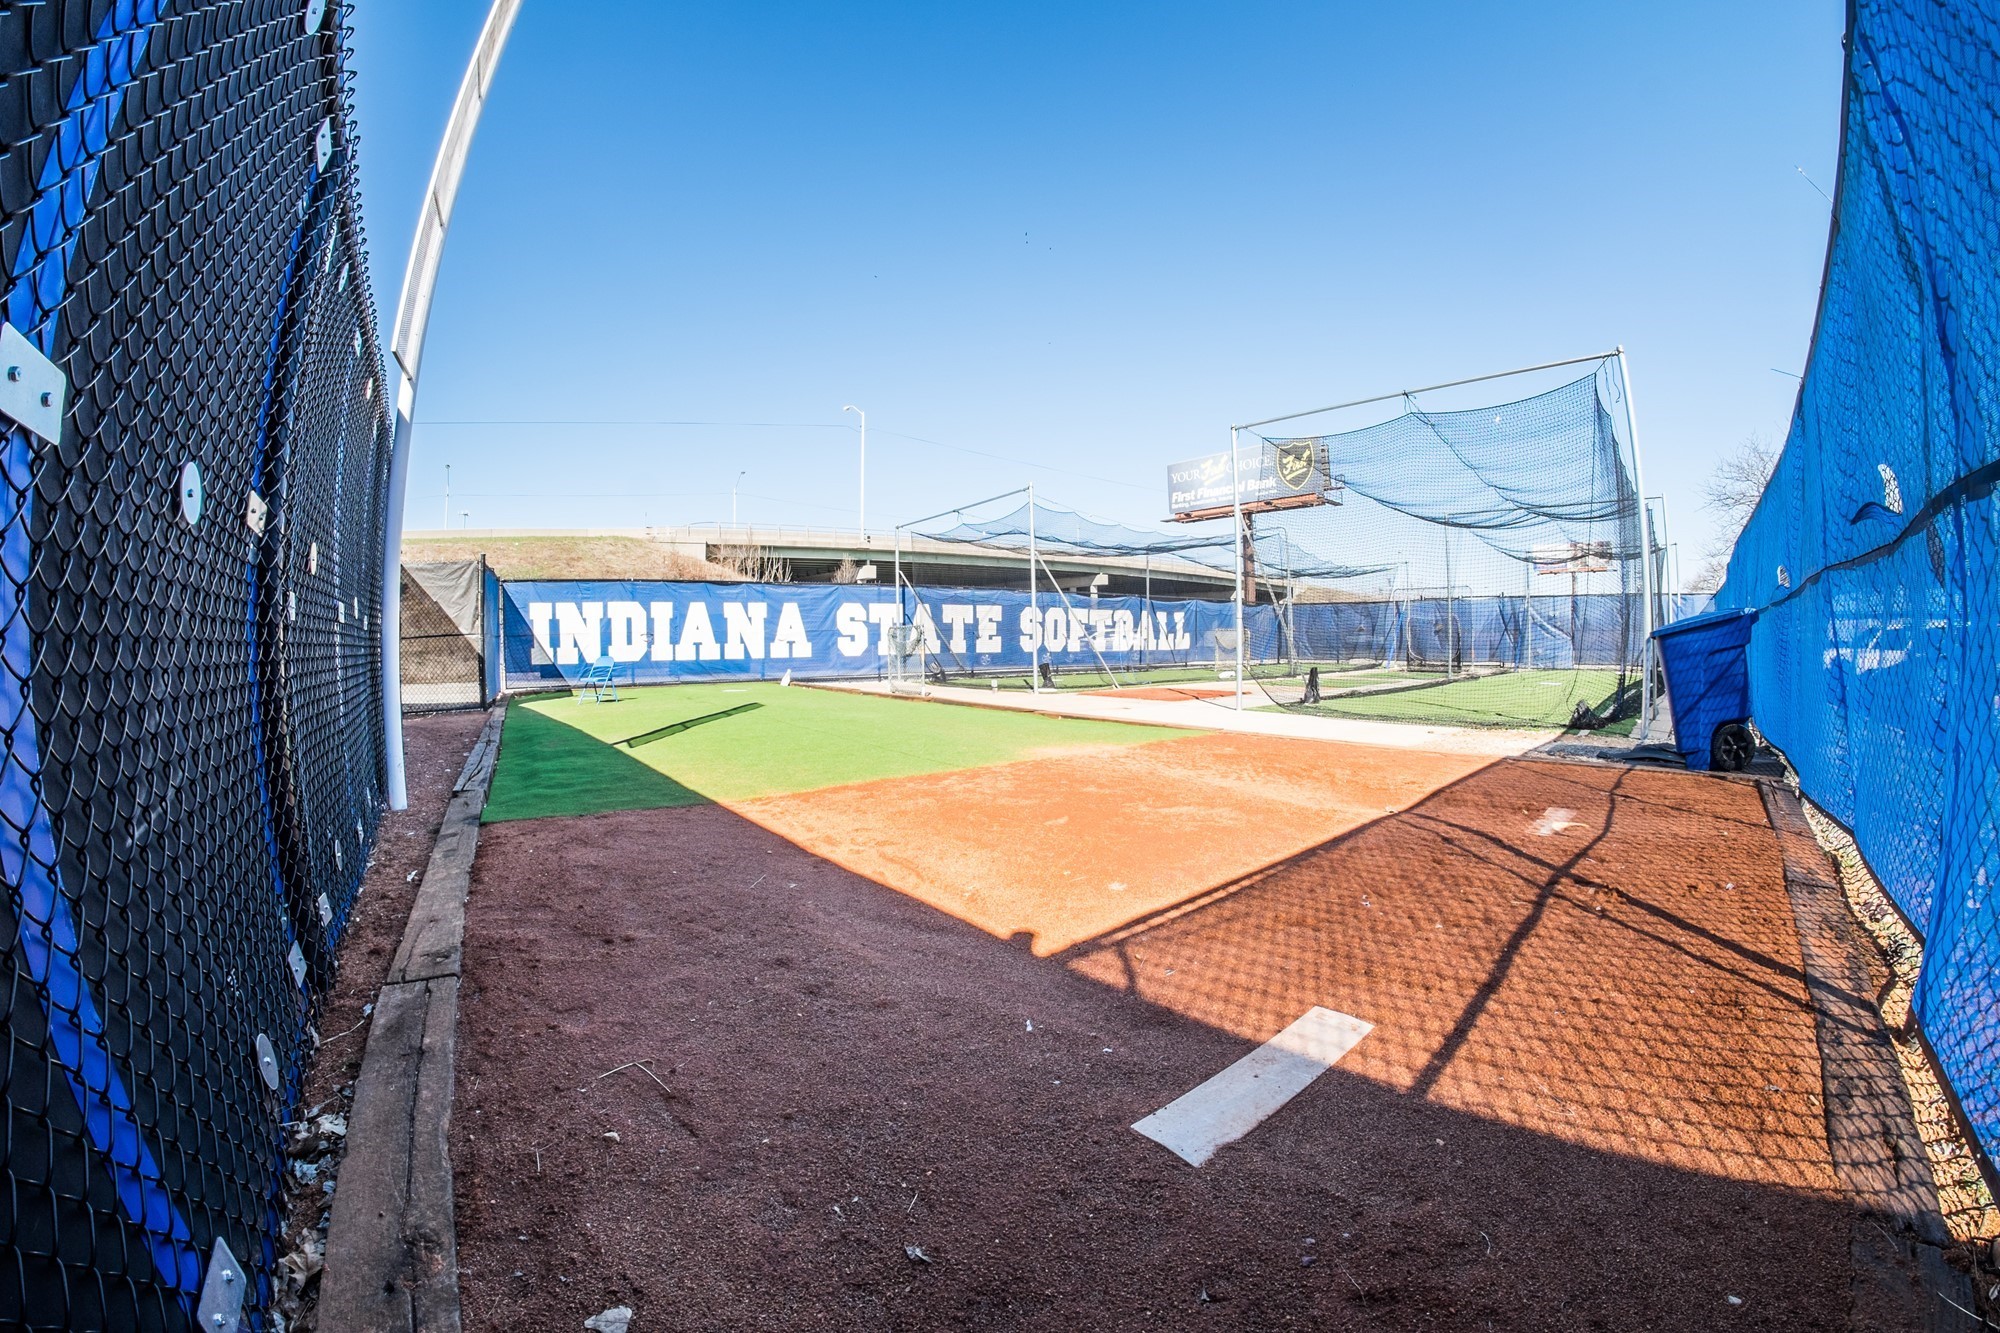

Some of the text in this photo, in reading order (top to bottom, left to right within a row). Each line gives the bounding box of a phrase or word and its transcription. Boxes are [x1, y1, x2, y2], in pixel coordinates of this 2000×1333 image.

[1171, 469, 1200, 484] YOUR
[1226, 454, 1272, 473] CHOICE
[1282, 448, 1312, 478] First
[1172, 489, 1196, 504] First
[1197, 480, 1246, 500] Financil
[1247, 476, 1277, 491] Bank
[529, 601, 1191, 665] INDIANA STATE SOFTBALL
